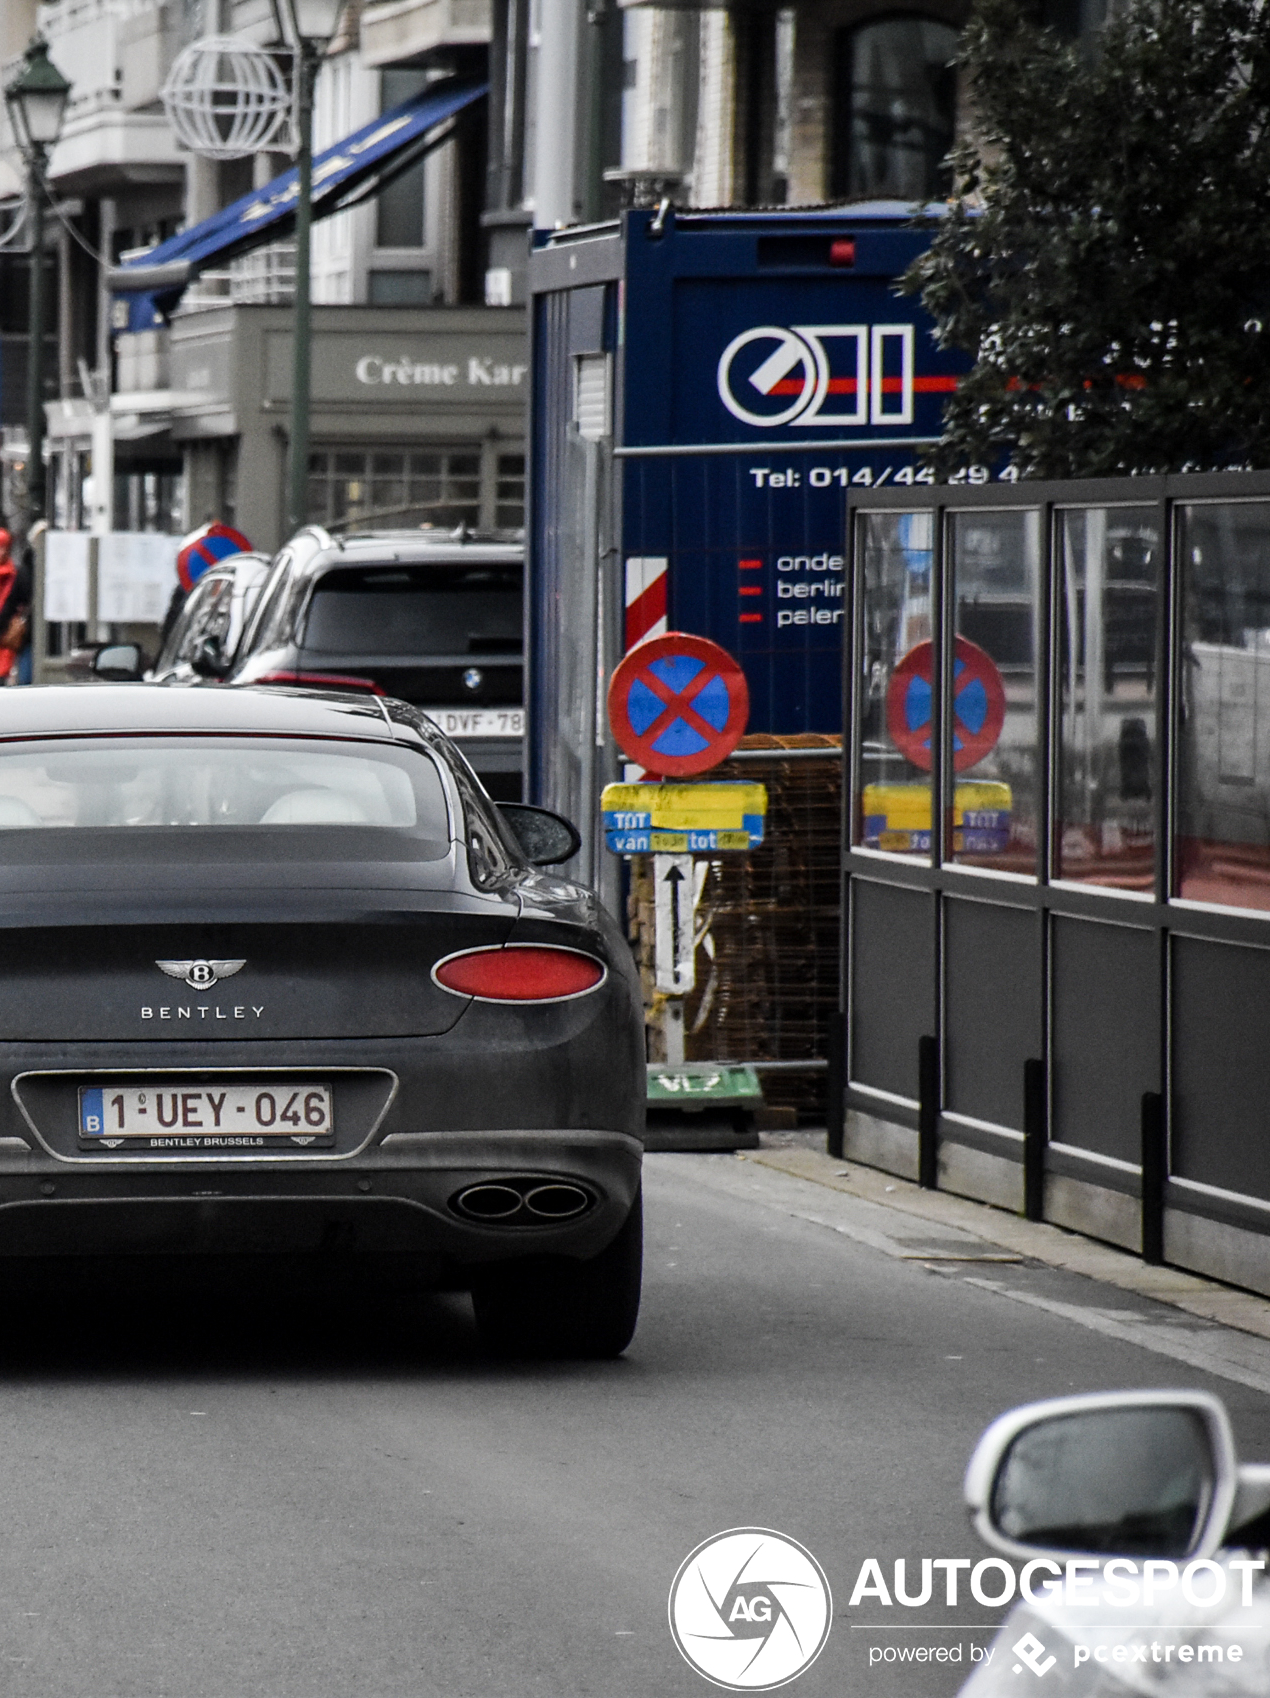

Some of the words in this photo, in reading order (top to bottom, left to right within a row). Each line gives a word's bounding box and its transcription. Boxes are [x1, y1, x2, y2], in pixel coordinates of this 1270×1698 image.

[355, 354, 459, 385] Crème
[749, 467, 801, 488] Tel:
[614, 837, 648, 850] van
[690, 832, 717, 849] tot
[141, 1006, 264, 1019] BENTLEY
[86, 1115, 99, 1132] B
[110, 1092, 326, 1129] 1-UEY-046
[150, 1137, 201, 1148] BENTLEY
[203, 1136, 264, 1147] BRUSSELS
